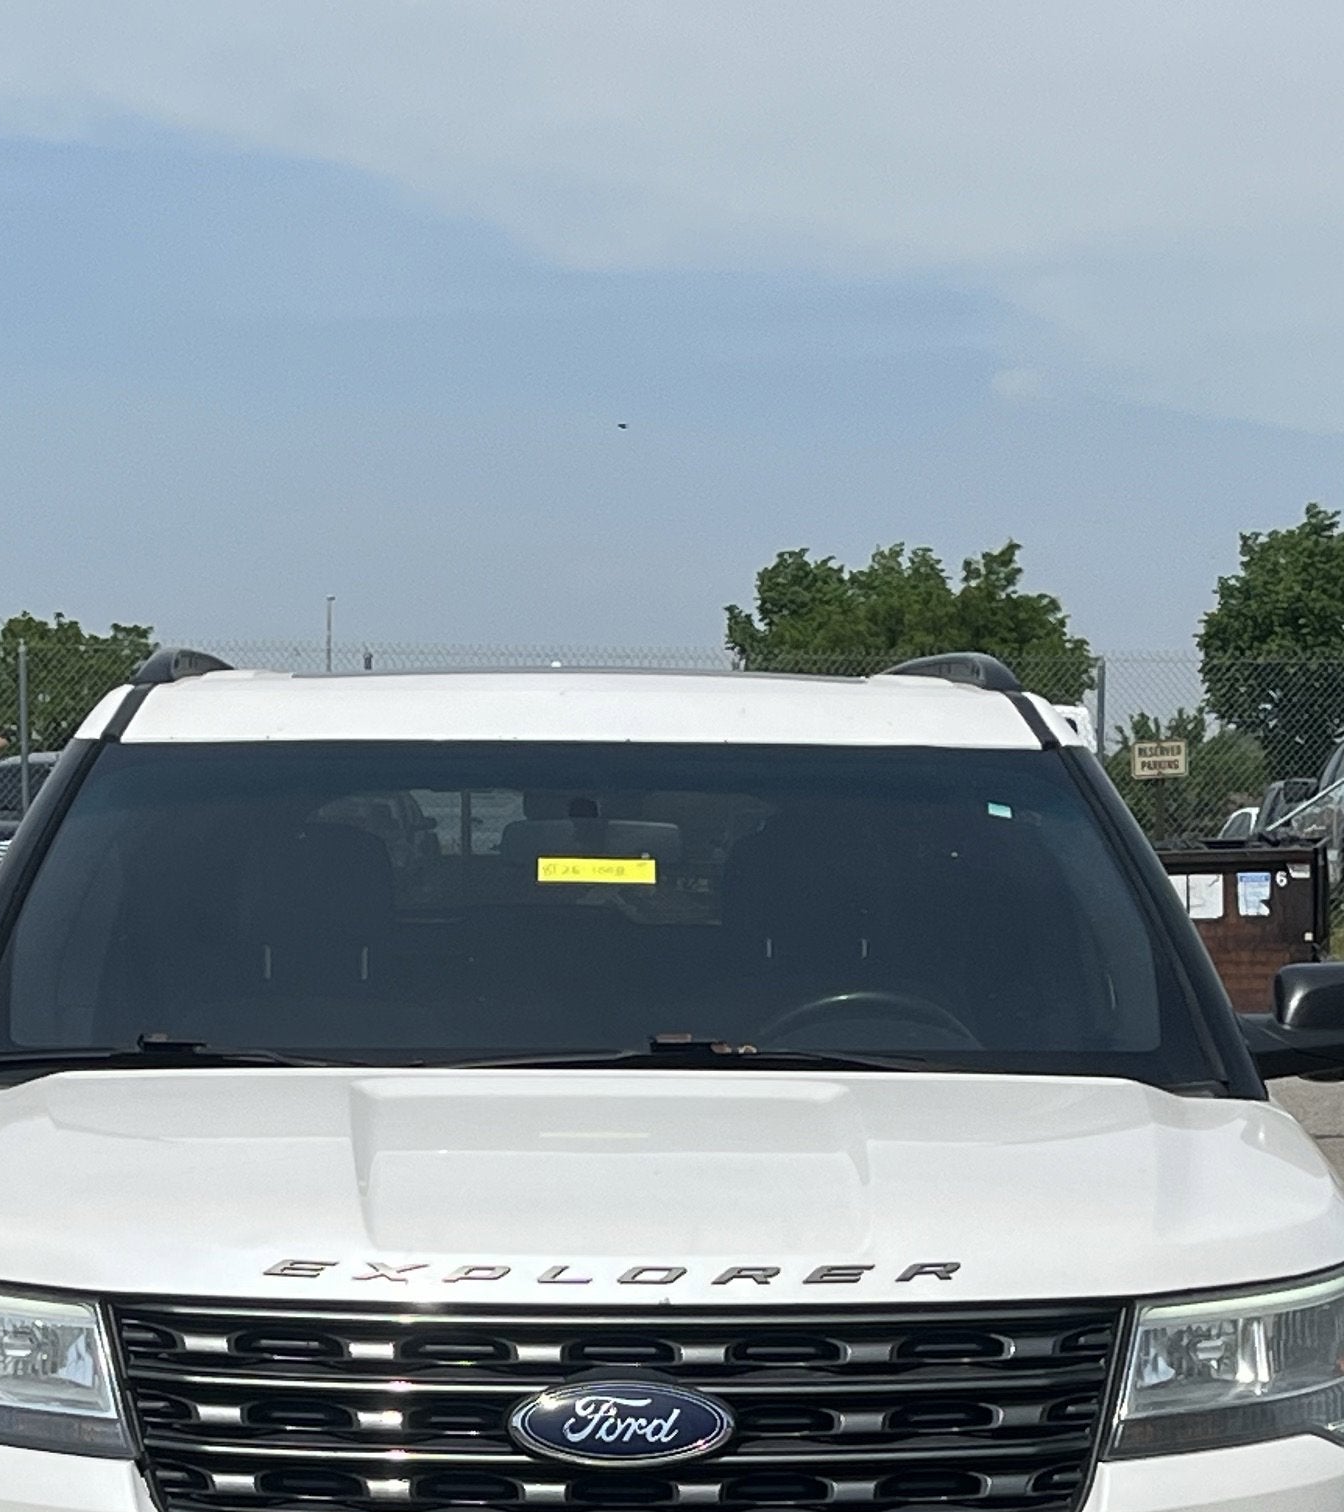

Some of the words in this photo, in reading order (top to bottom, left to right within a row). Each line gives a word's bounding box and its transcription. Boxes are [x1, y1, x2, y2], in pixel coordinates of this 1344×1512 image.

[1275, 870, 1288, 888] 6
[263, 1258, 962, 1285] EXPLORER
[562, 1395, 681, 1443] Ford
